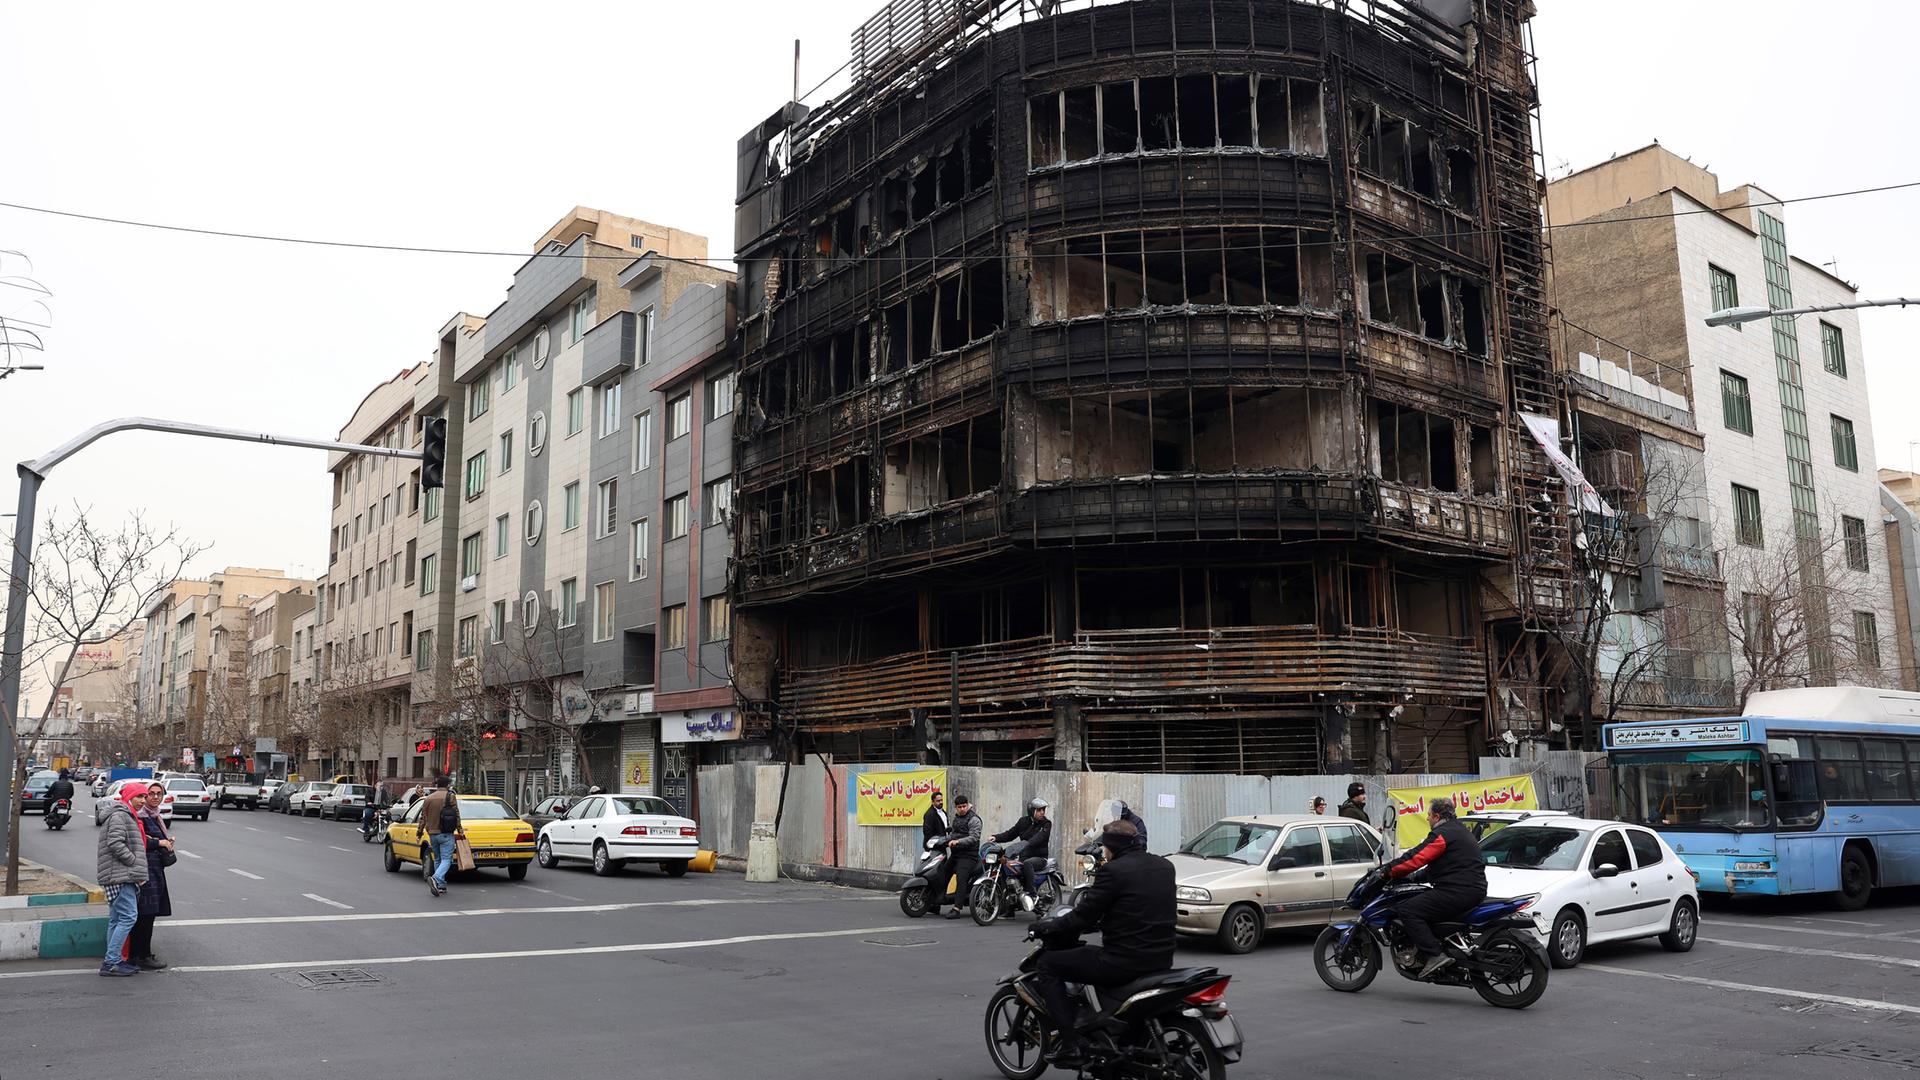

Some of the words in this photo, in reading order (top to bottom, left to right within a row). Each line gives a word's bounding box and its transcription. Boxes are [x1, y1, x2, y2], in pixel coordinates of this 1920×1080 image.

[860, 781, 876, 796] است
[878, 781, 895, 800] ایمن
[905, 778, 941, 799] ساختمان
[1473, 785, 1525, 811] ساختمان
[897, 808, 915, 820] احتیاط
[1398, 795, 1425, 816] است
